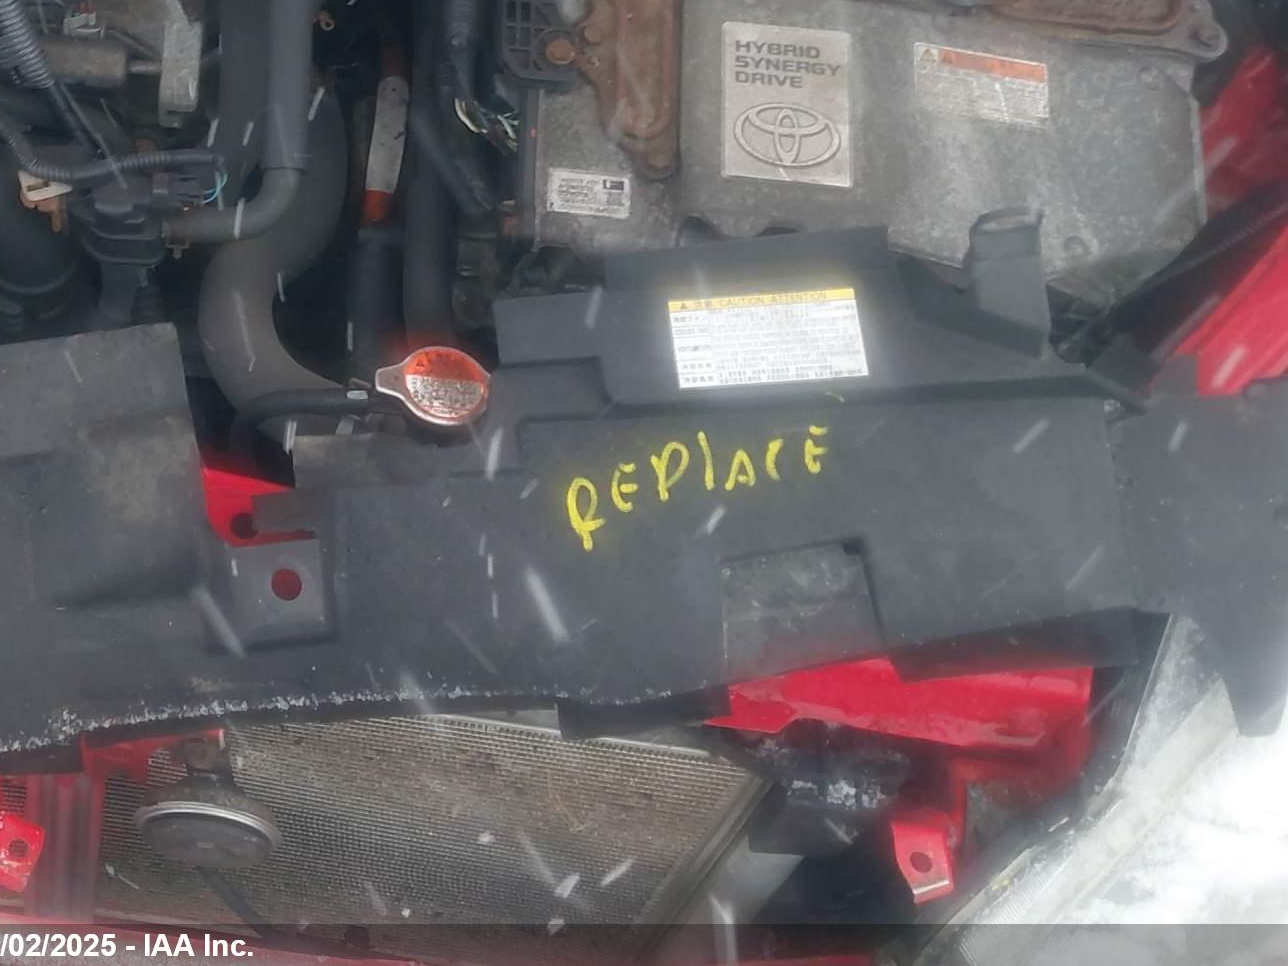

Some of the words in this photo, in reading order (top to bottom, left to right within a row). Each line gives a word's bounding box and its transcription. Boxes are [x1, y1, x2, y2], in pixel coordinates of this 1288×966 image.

[735, 40, 820, 59] HYBRID
[735, 56, 841, 76] SYNERGY
[735, 71, 803, 88] DRIVE
